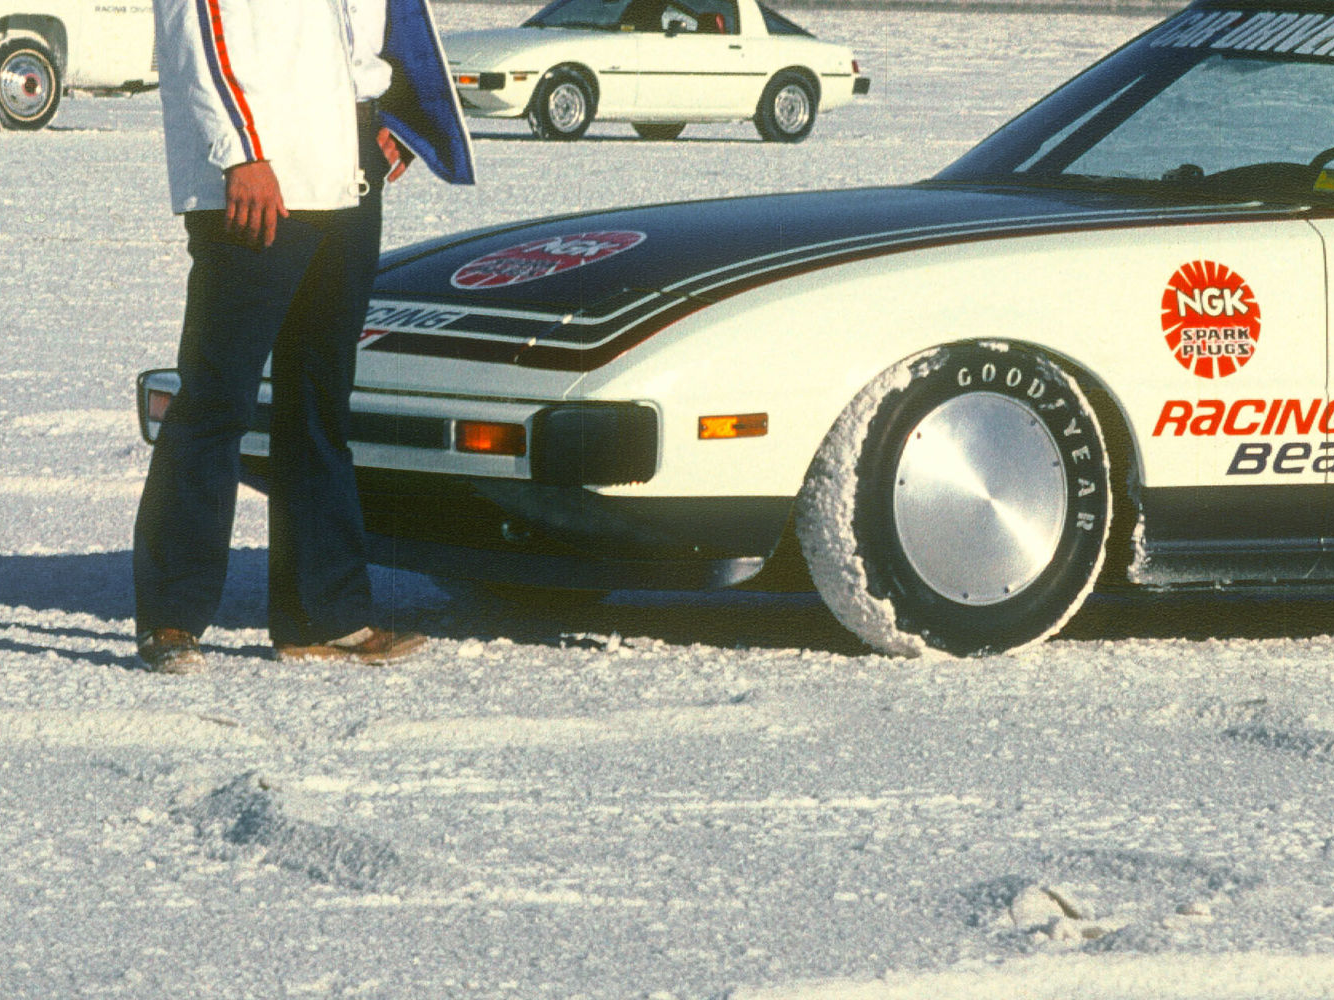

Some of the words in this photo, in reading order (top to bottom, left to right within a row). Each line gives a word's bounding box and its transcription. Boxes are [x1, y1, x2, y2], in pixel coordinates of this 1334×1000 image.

[1176, 286, 1249, 317] NGK
[365, 306, 464, 329] CING
[1181, 327, 1250, 342] SPARK
[1181, 342, 1251, 358] PLUGS
[958, 363, 1097, 531] GOODYEAR
